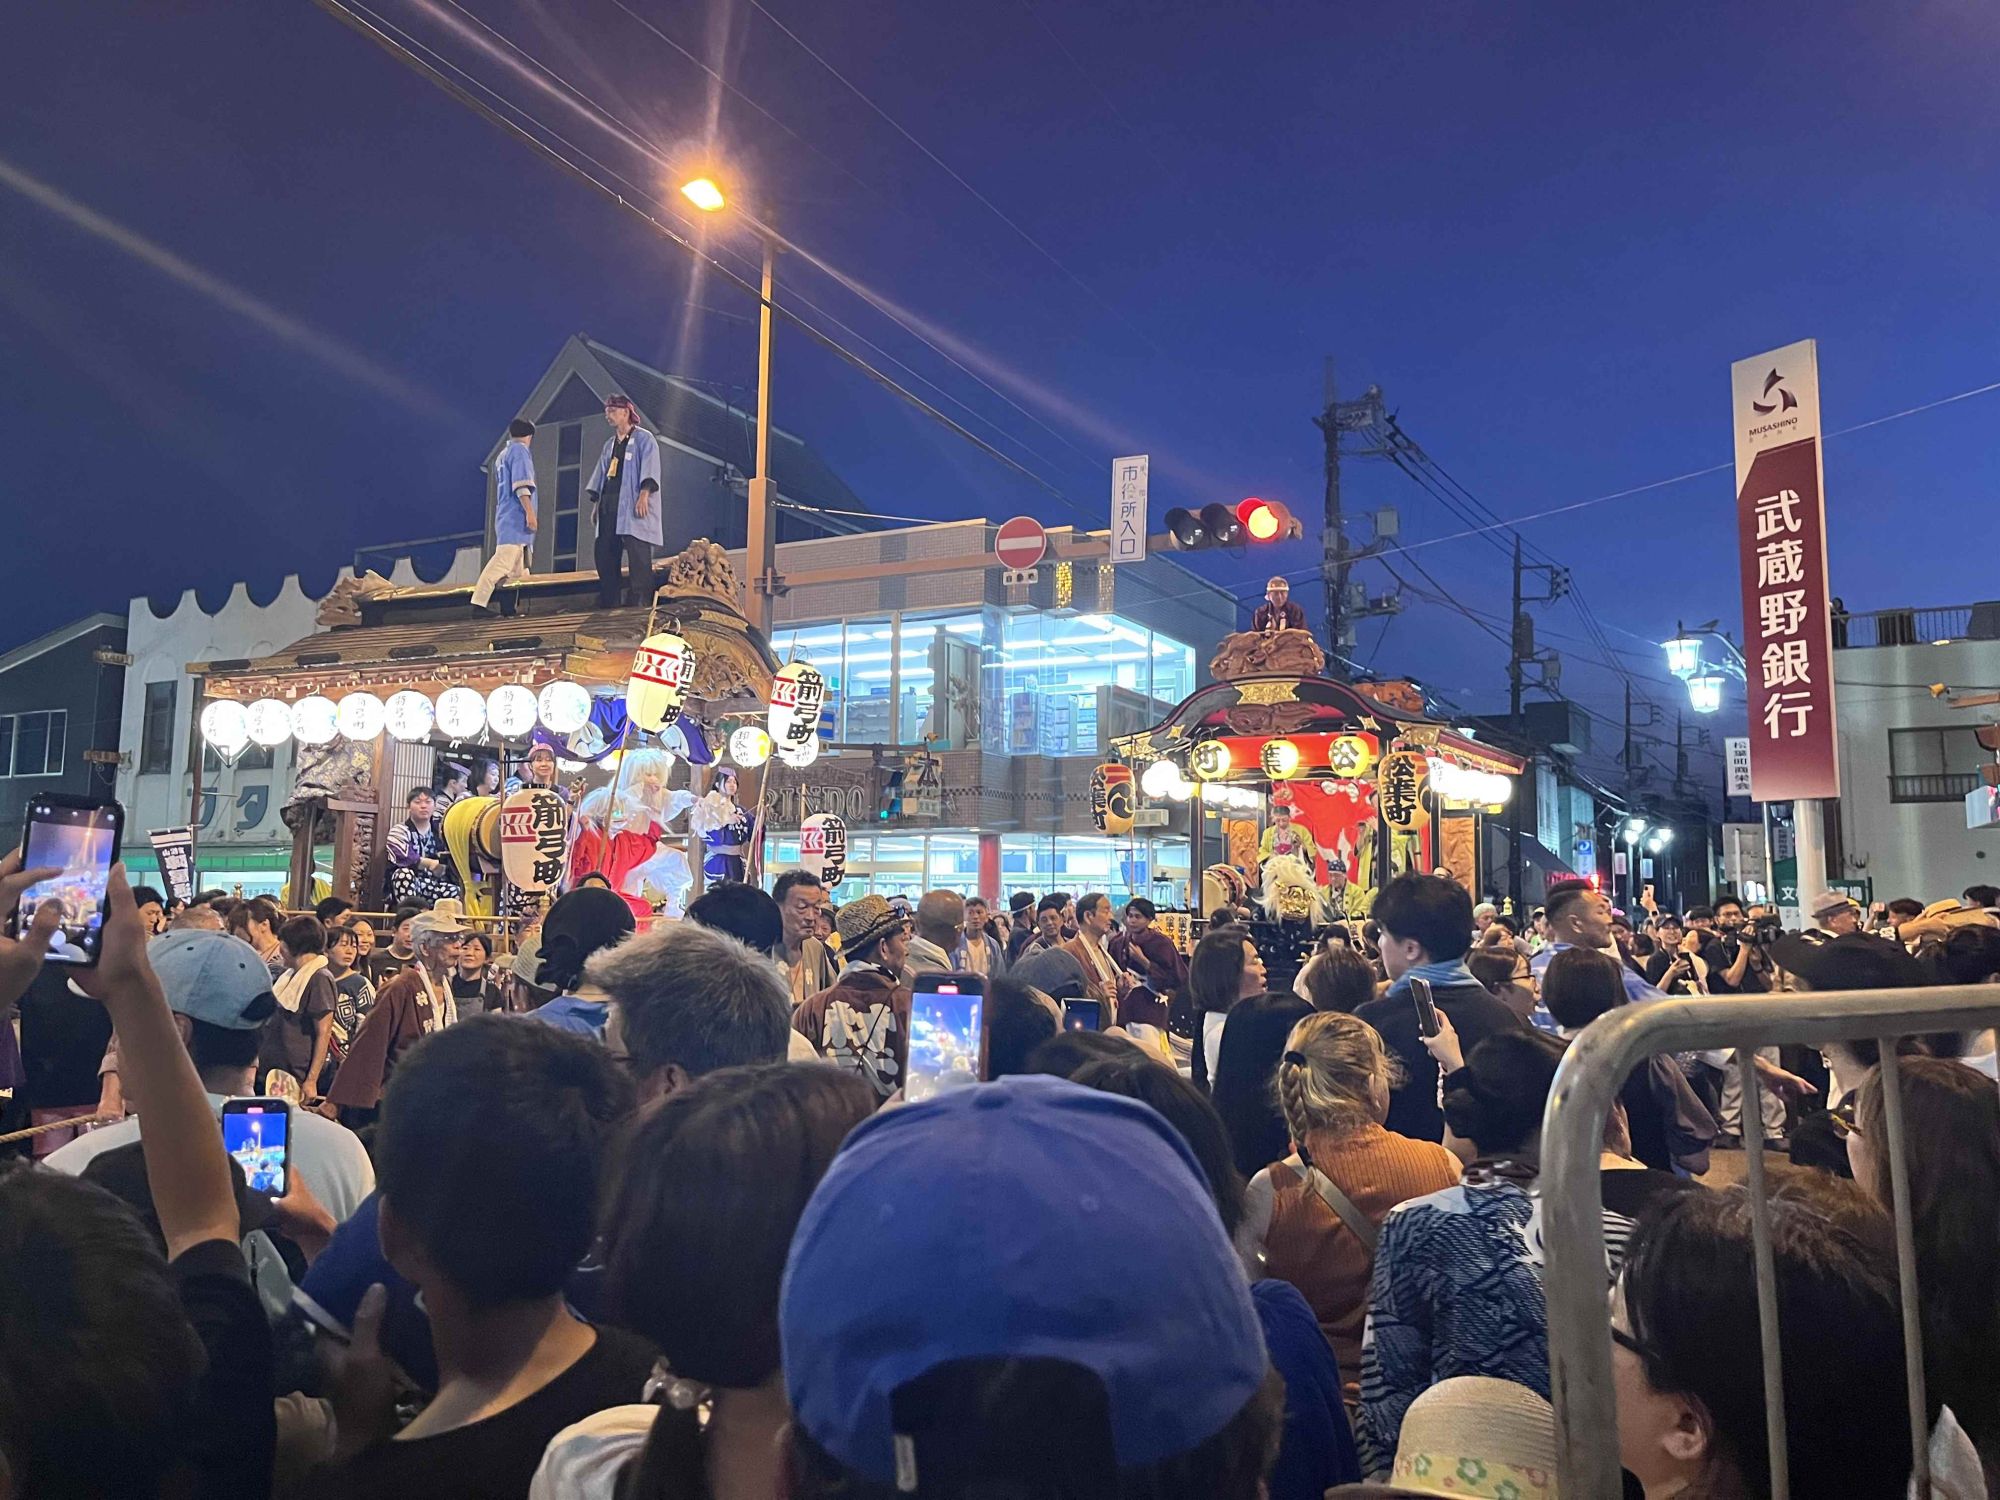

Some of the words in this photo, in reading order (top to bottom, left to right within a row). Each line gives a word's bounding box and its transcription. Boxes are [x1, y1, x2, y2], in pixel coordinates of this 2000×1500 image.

[1748, 417, 1798, 436] MUSASHINO
[1120, 466, 1138, 554] 市役所入口
[1755, 489, 1813, 739] 武蔵野銀行
[786, 669, 823, 744] 箭弓町
[1381, 754, 1417, 825] 松葉町
[531, 793, 567, 885] 箭弓町
[821, 817, 846, 887] 箭弓町
